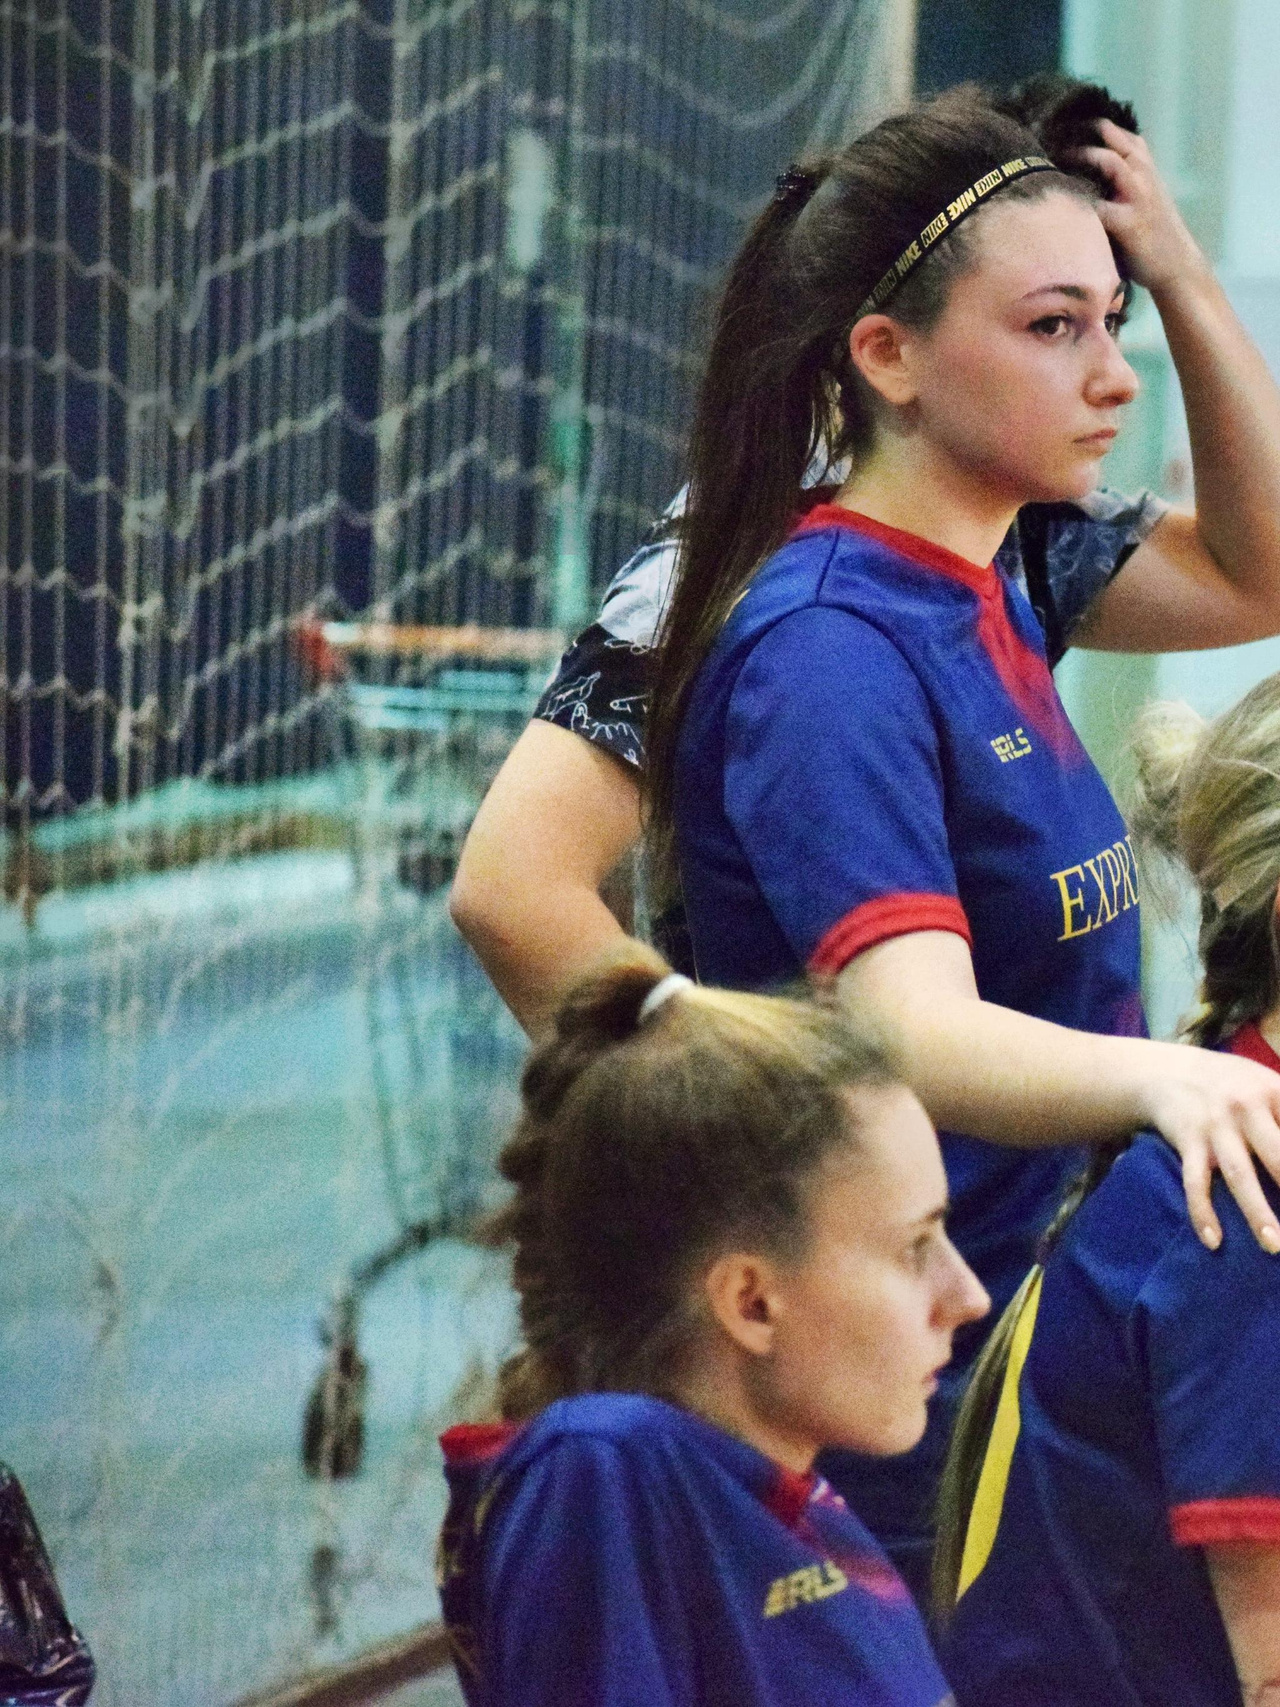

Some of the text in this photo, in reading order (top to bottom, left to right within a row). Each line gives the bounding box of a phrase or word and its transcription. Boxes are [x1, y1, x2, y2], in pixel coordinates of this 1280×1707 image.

[895, 240, 922, 276] NIKE
[920, 212, 949, 248] NIKE
[946, 188, 976, 220] NIKE
[974, 169, 1003, 197] NIKE
[1001, 158, 1027, 177] NIKE
